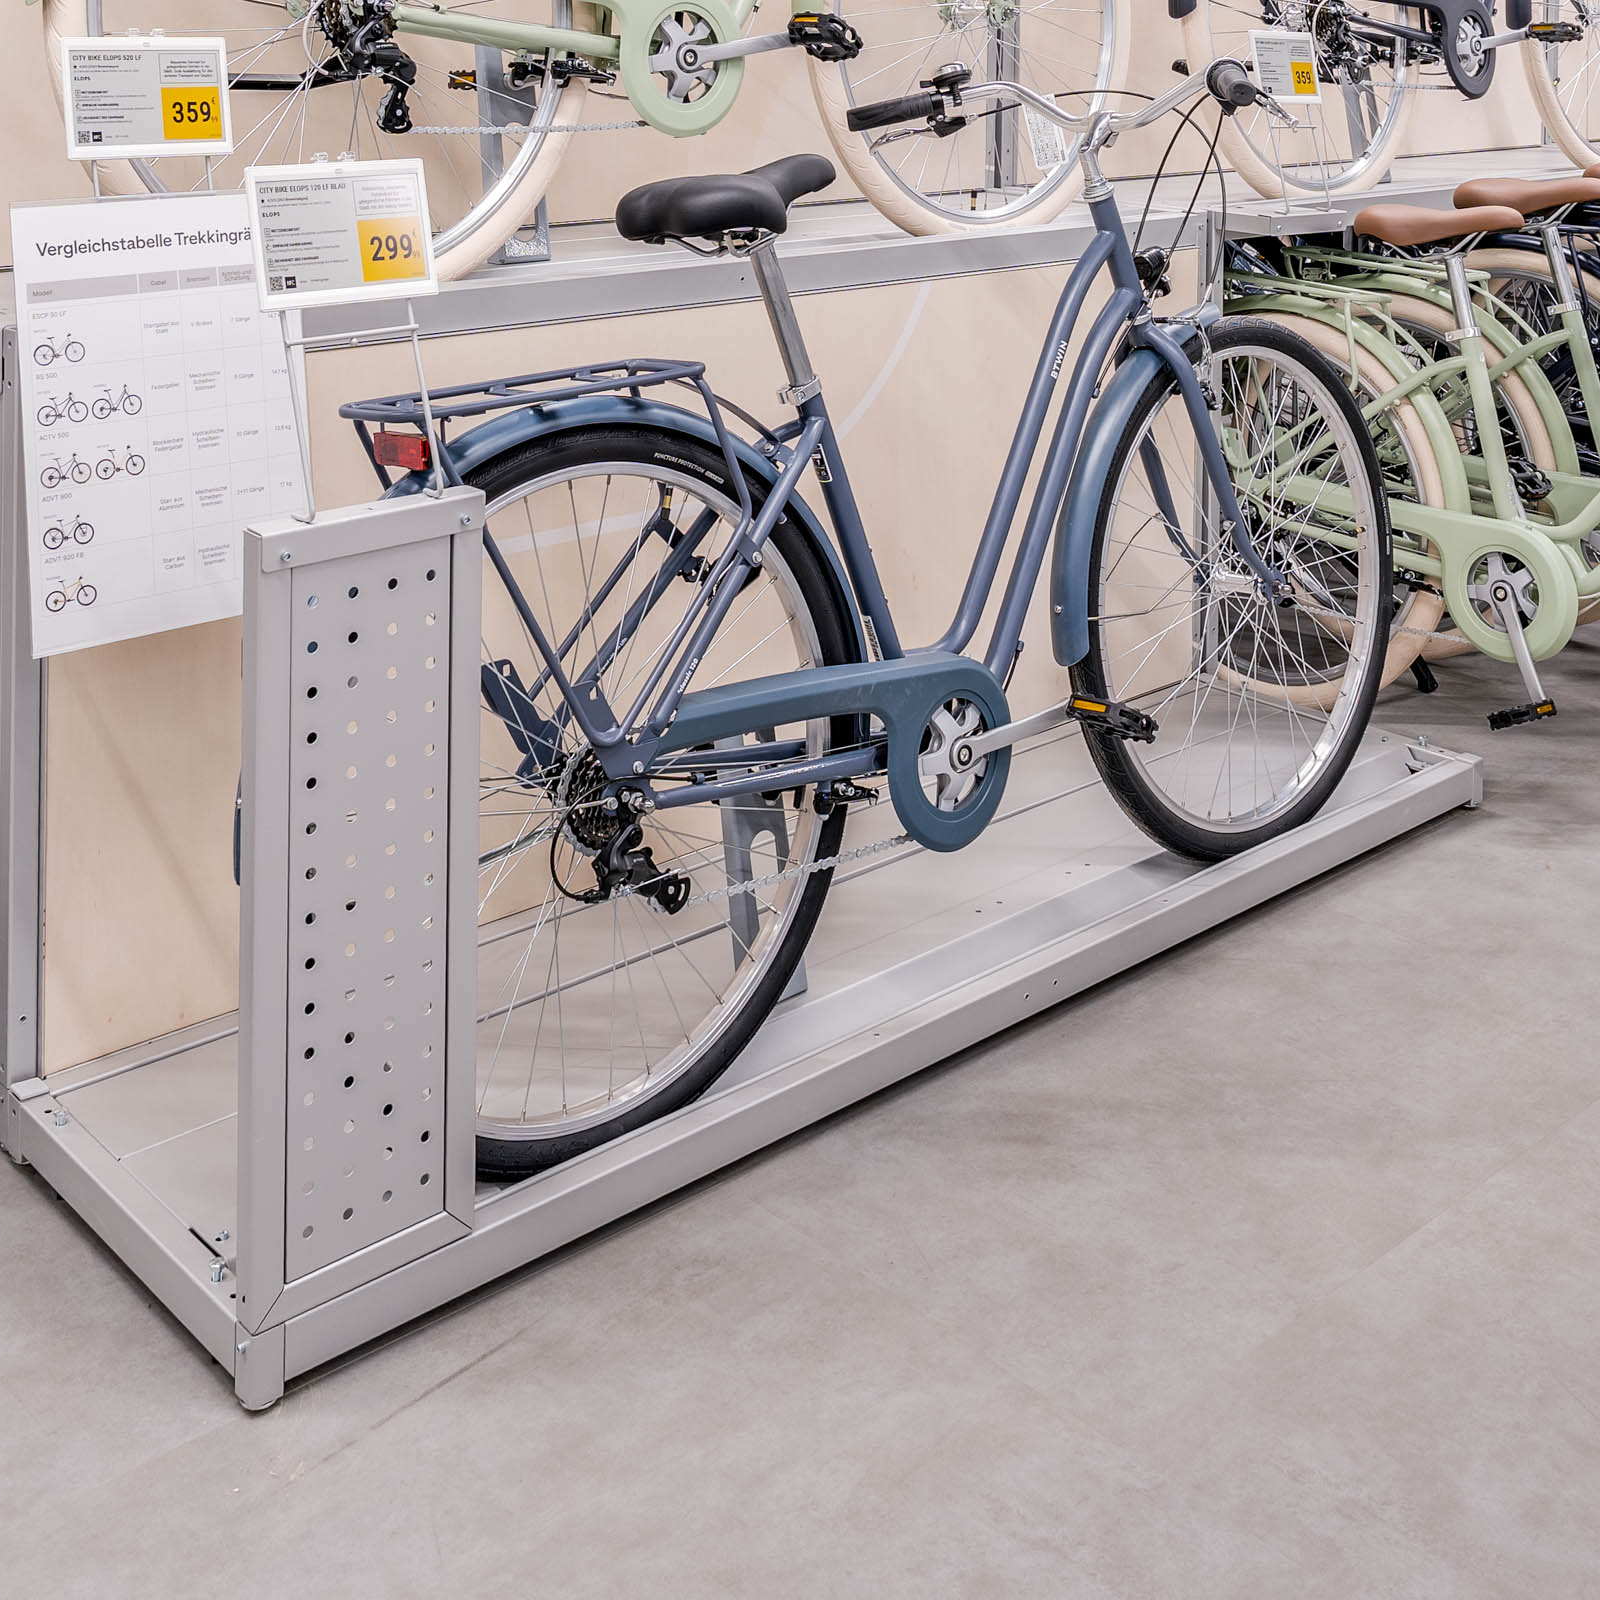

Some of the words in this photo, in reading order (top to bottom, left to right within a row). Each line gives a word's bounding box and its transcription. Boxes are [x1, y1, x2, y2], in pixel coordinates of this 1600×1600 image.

[1295, 71, 1311, 84] 359
[172, 101, 211, 123] 359
[36, 233, 172, 258] Vergleichstabelle
[370, 234, 412, 262] 299
[1050, 340, 1068, 380] BTWIN
